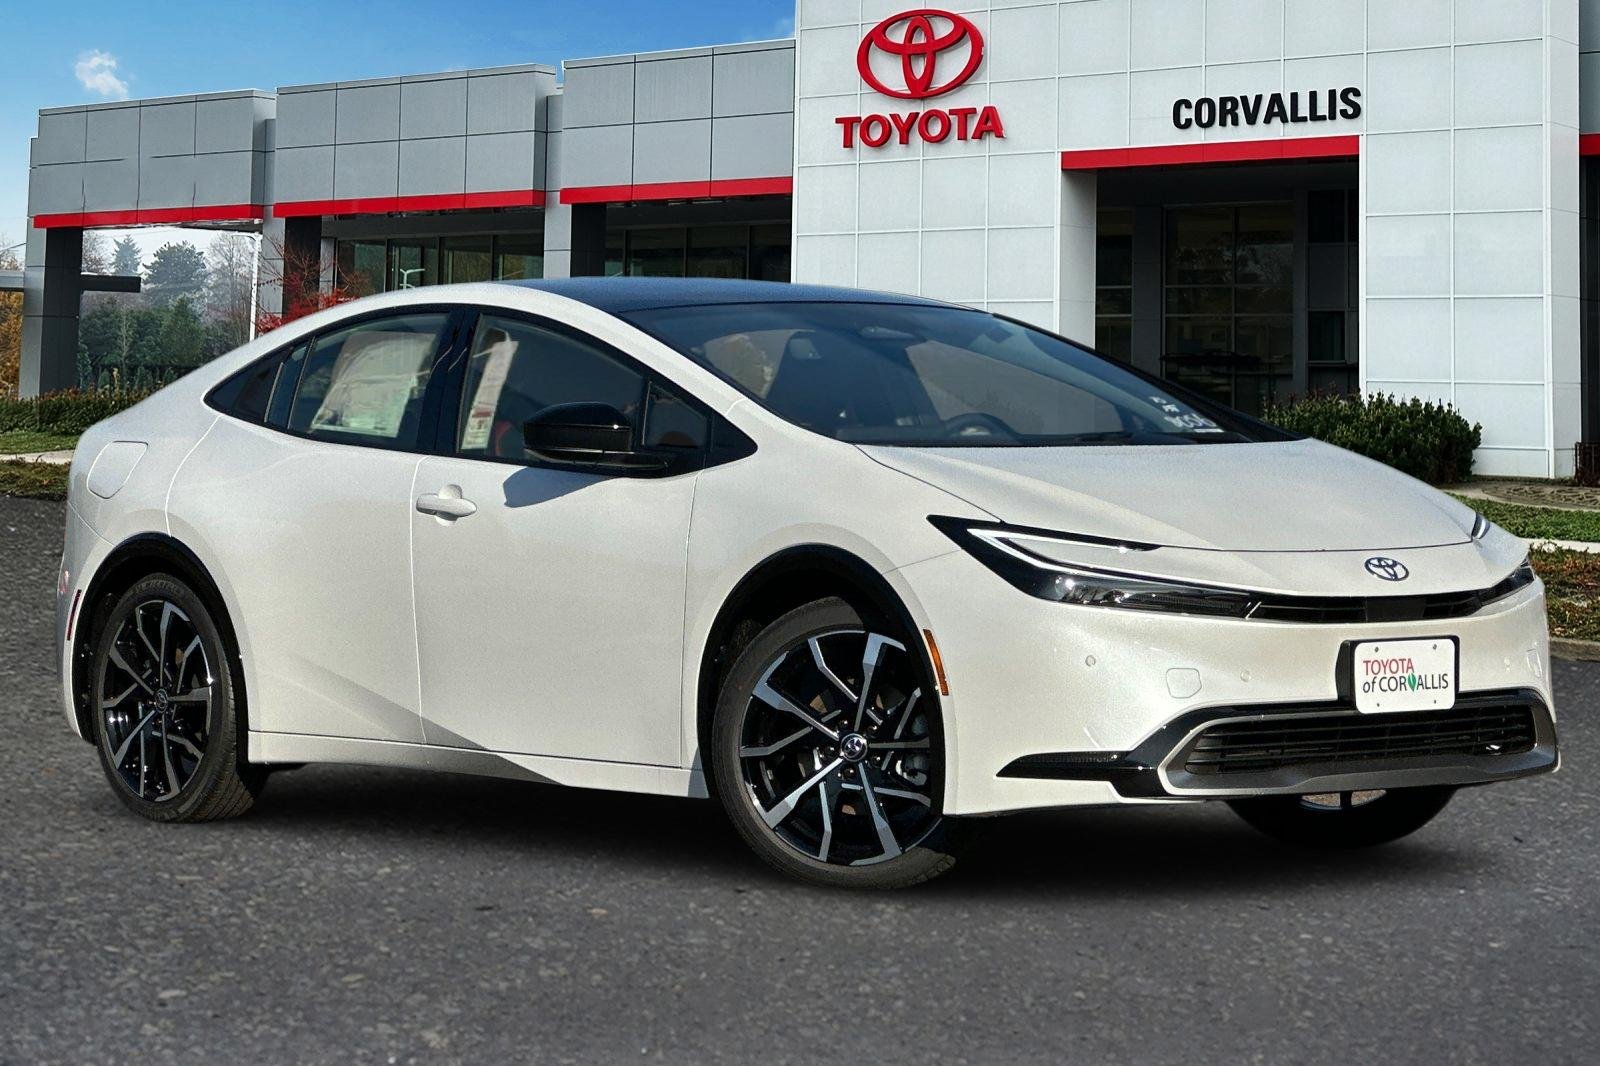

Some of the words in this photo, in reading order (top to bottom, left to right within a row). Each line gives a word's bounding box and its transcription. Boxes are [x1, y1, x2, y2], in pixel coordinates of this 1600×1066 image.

[1172, 86, 1362, 130] CORVALLIS
[835, 105, 1005, 148] TOYOTA
[1362, 658, 1415, 676] TOYOTA
[1362, 676, 1377, 693] of
